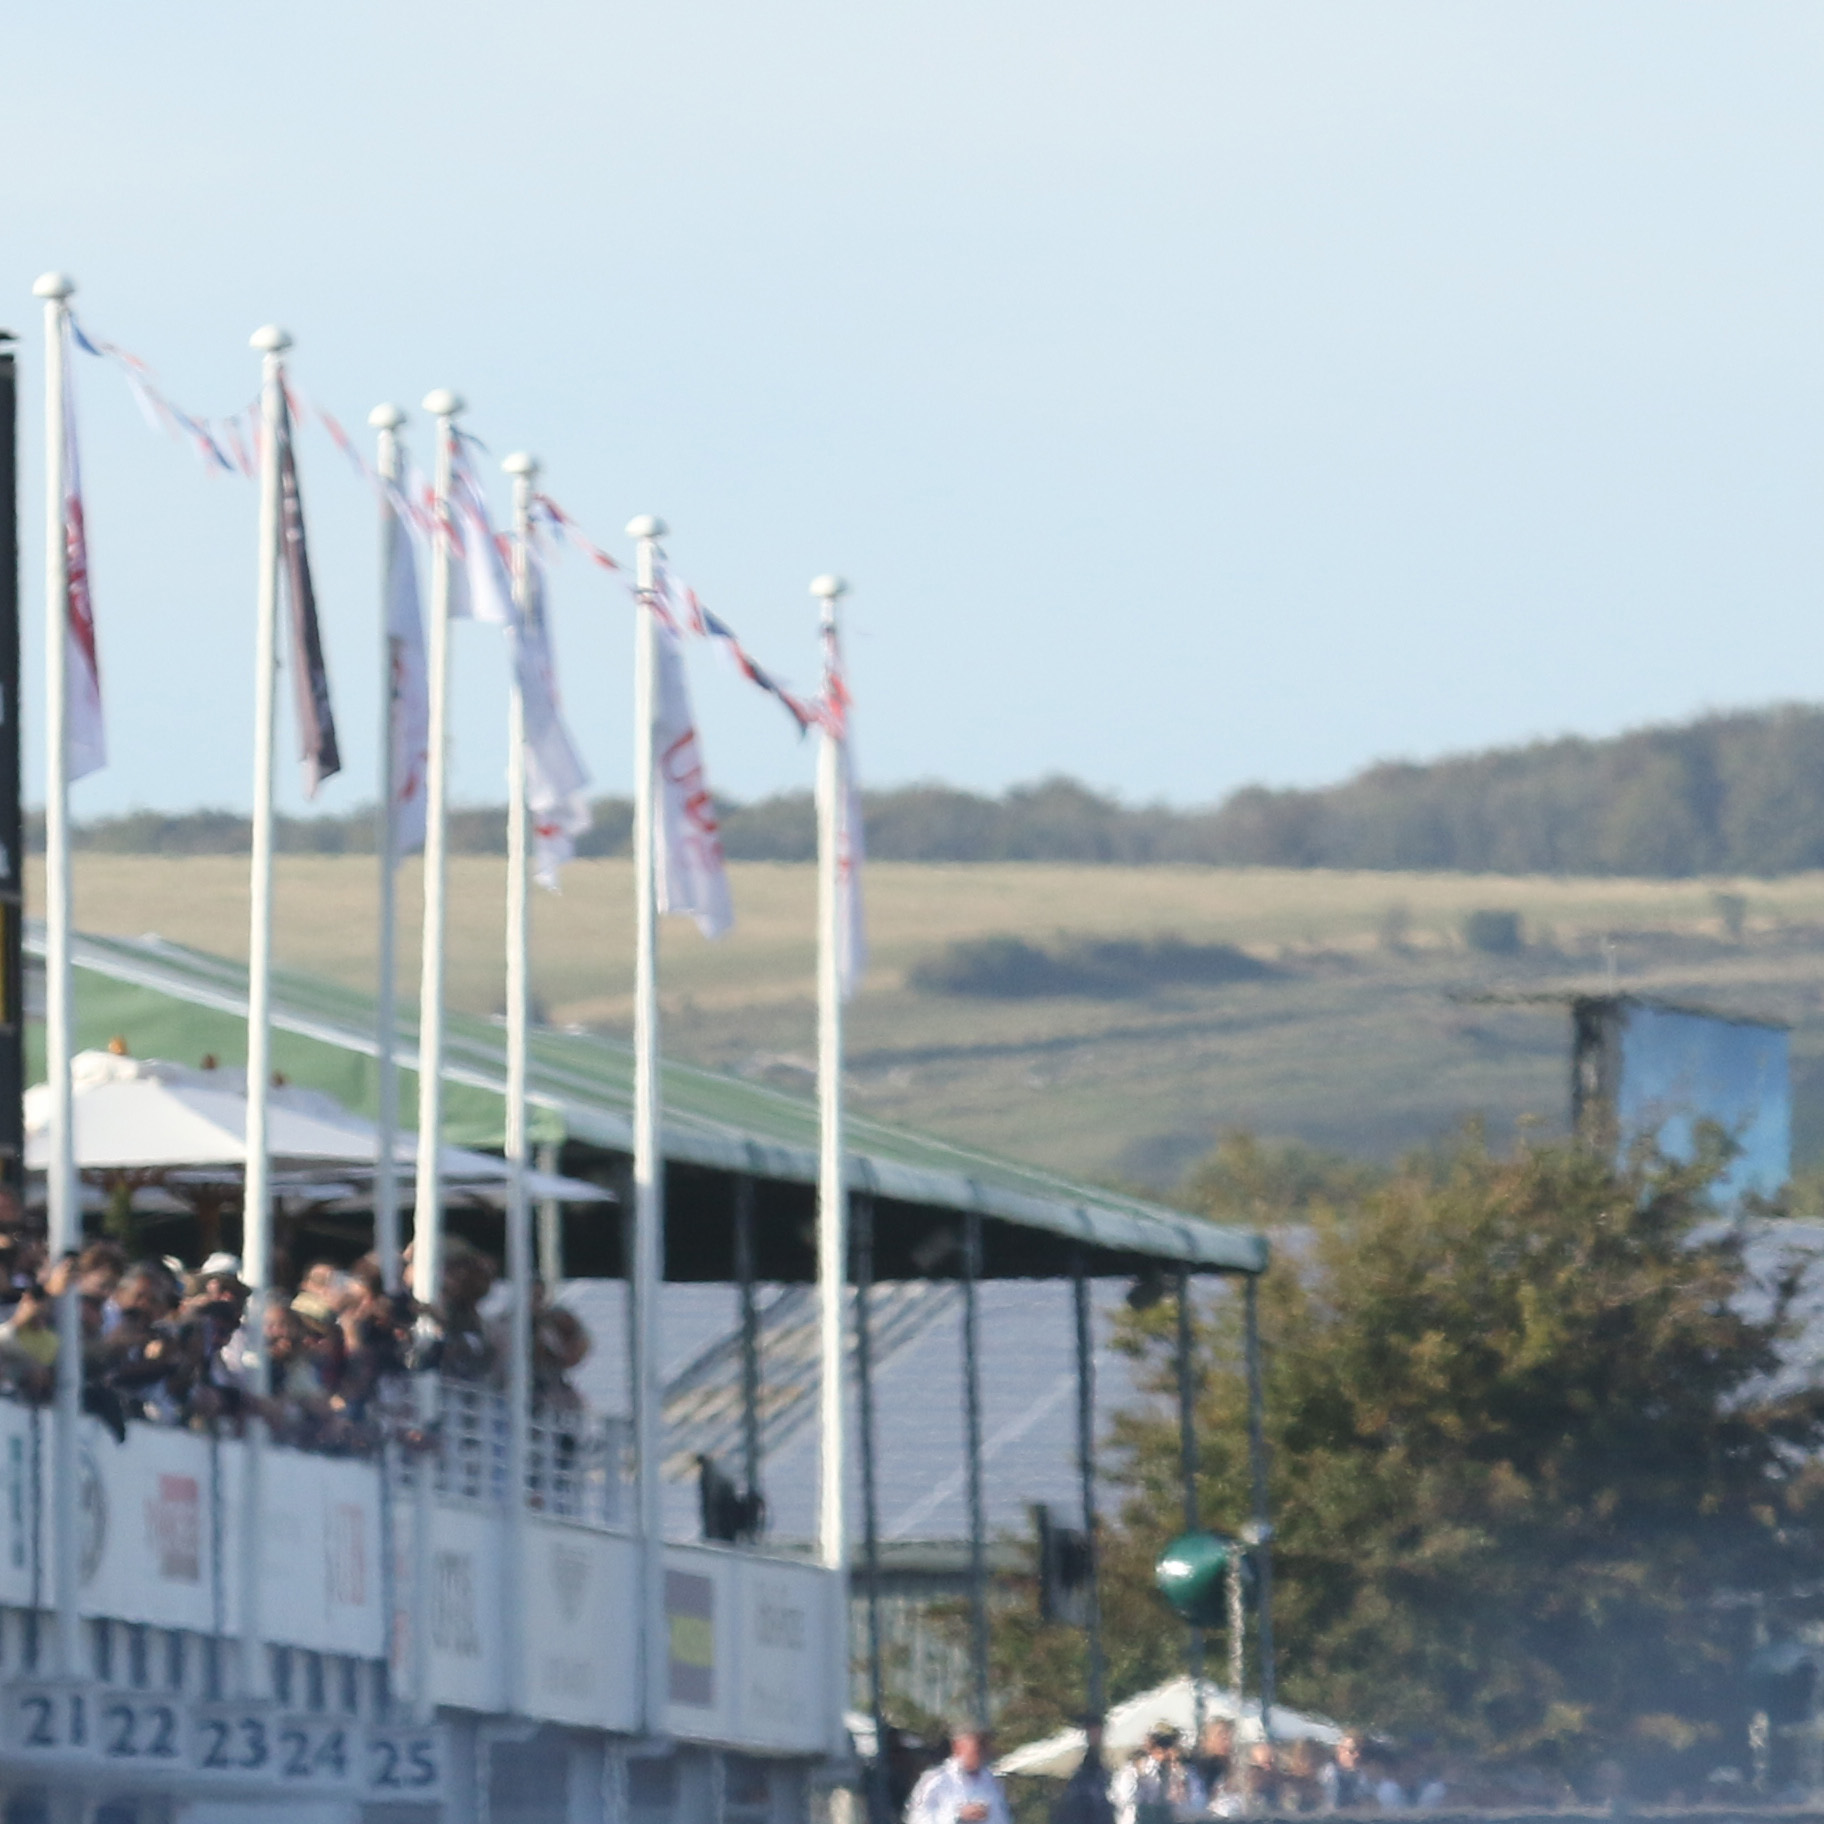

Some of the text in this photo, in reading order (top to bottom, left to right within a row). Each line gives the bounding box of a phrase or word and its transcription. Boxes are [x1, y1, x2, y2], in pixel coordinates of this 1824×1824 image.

[22, 1697, 86, 1748] 21
[104, 1705, 181, 1759] 22
[200, 1719, 270, 1770] 23
[281, 1730, 348, 1778] 24
[365, 1738, 438, 1789] 25
